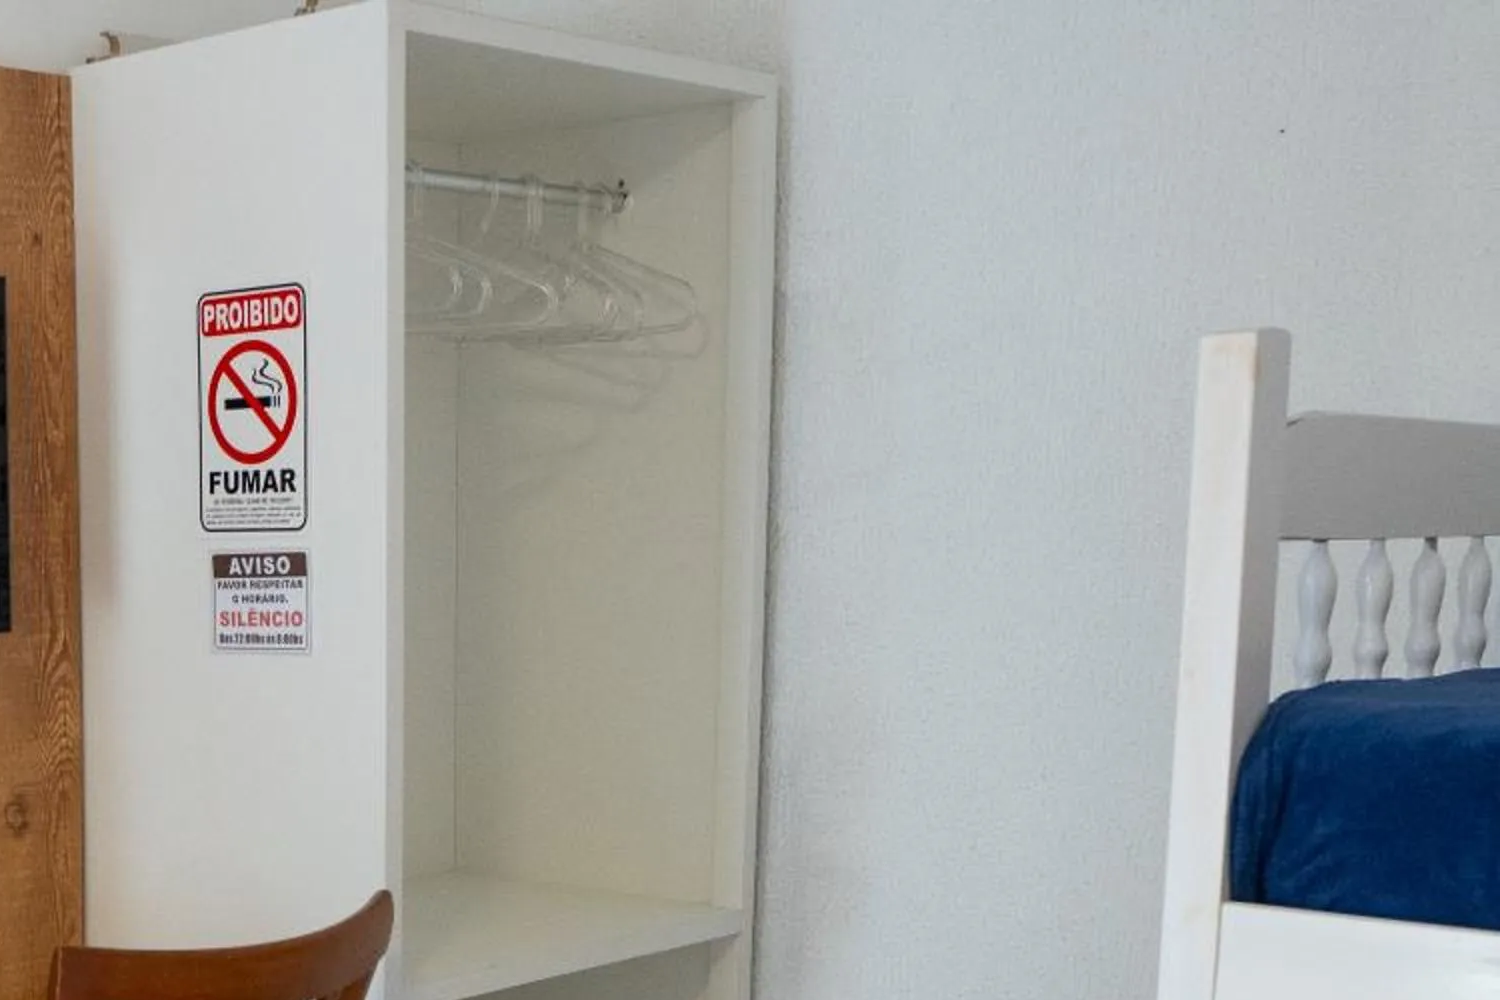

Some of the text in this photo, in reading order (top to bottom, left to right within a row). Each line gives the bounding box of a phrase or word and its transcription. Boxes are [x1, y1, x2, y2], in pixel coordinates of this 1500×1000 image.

[203, 294, 299, 333] PROIBIDO
[209, 469, 297, 495] FUMAR
[229, 555, 291, 575] AVISO
[219, 607, 303, 627] SILÊNCIO
